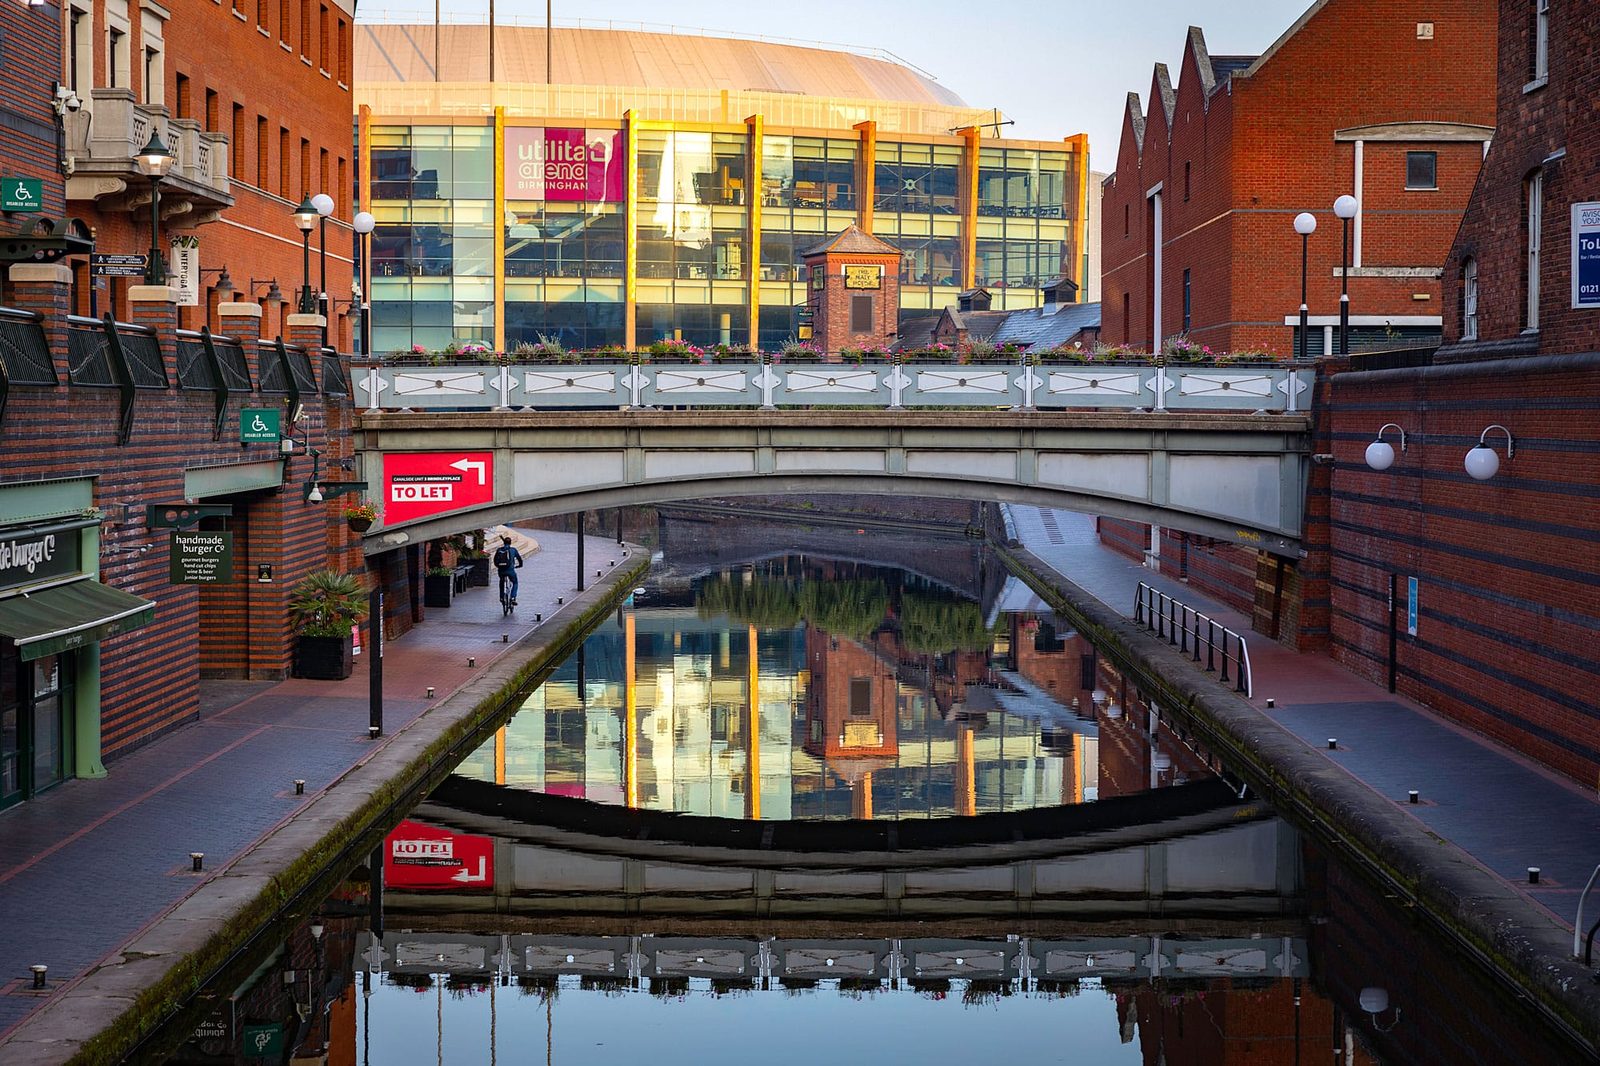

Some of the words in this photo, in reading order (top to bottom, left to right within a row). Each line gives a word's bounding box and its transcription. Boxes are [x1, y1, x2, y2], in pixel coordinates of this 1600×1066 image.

[518, 140, 587, 161] utilita
[518, 162, 588, 180] arena
[518, 181, 588, 190] BIRMINGHAM
[1580, 239, 1595, 250] To
[180, 250, 188, 289] INTERYOGA
[1580, 285, 1599, 293] 0121
[394, 487, 416, 498] TO
[421, 487, 449, 498] LET
[175, 534, 223, 544] handmade
[182, 544, 213, 555] burger
[12, 540, 44, 574] burger
